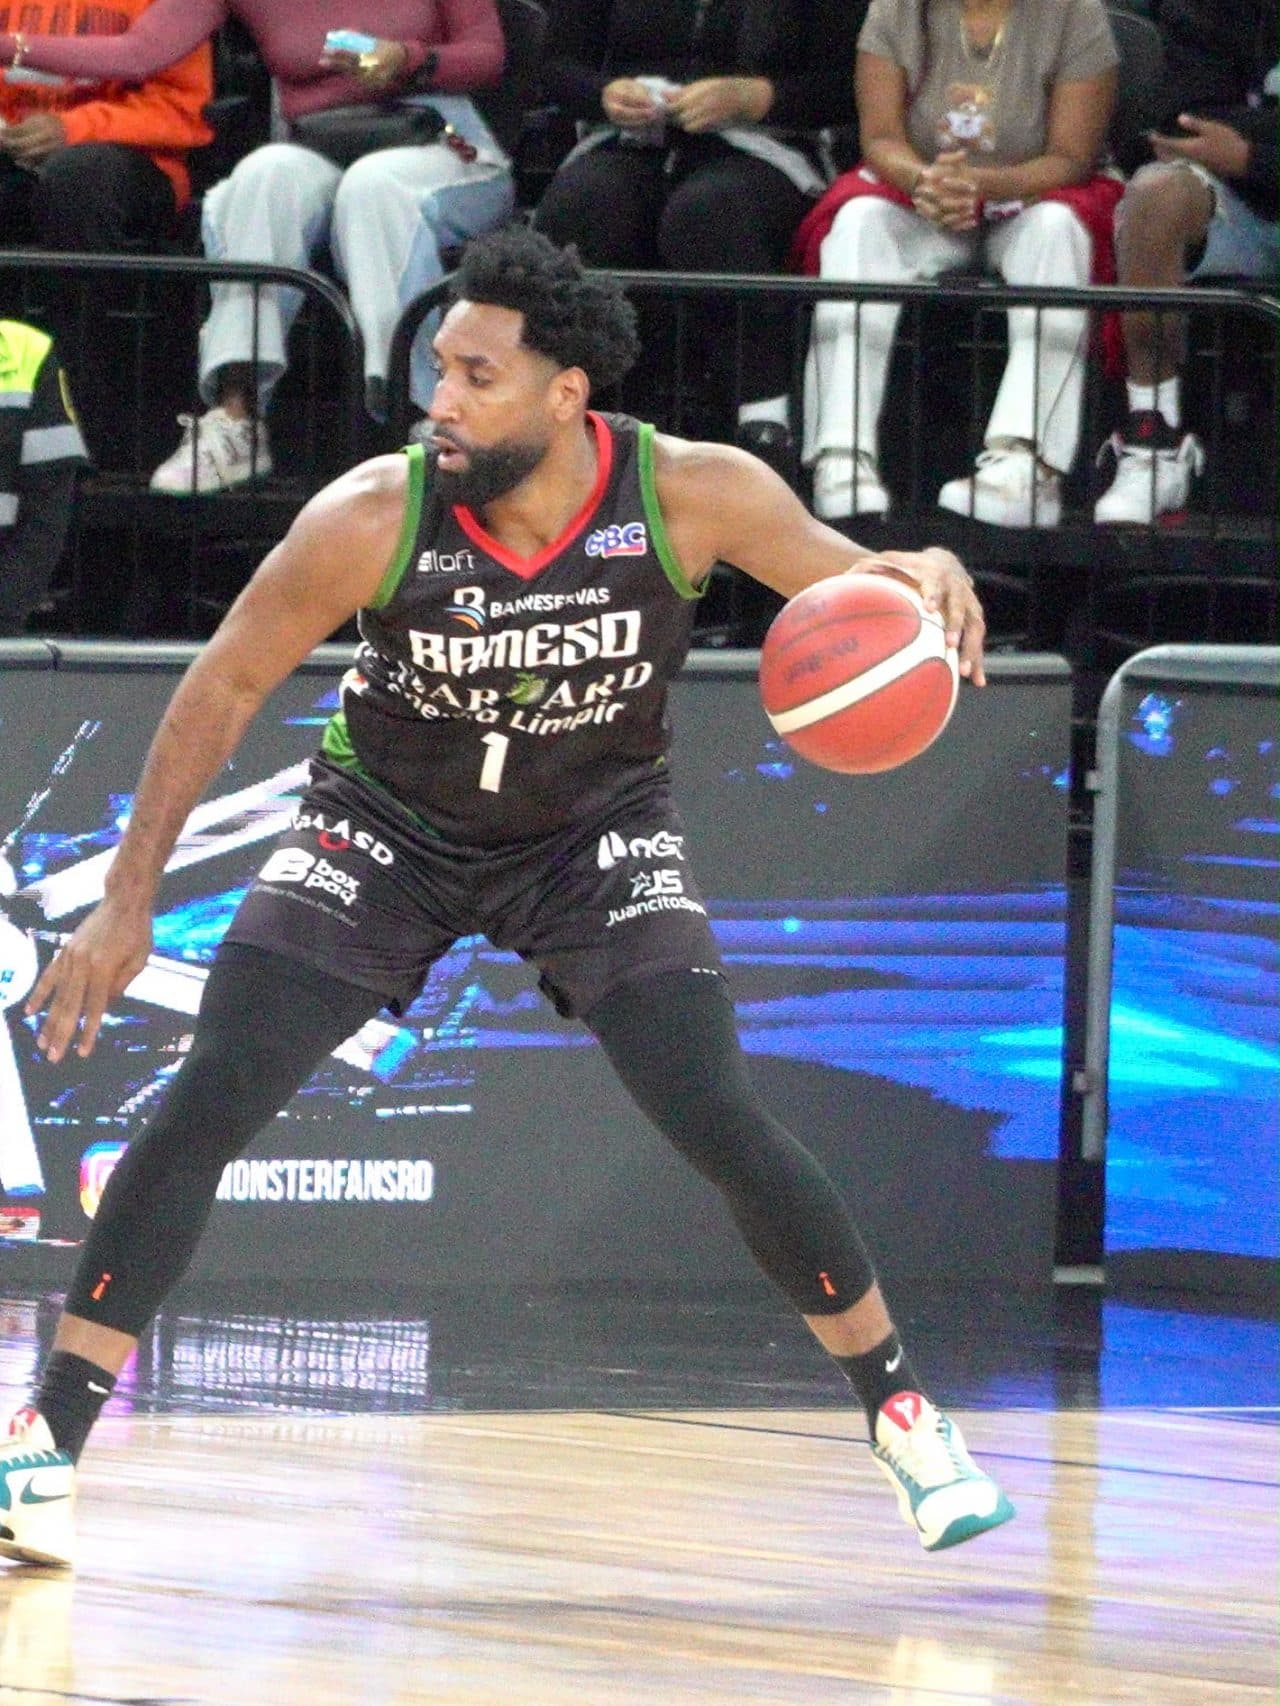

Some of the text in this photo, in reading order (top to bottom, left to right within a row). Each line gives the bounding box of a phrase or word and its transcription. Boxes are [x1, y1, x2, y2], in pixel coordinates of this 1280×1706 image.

[408, 609, 642, 678] BAMESO
[479, 731, 510, 793] 1
[303, 872, 358, 906] paq
[313, 858, 361, 893] box
